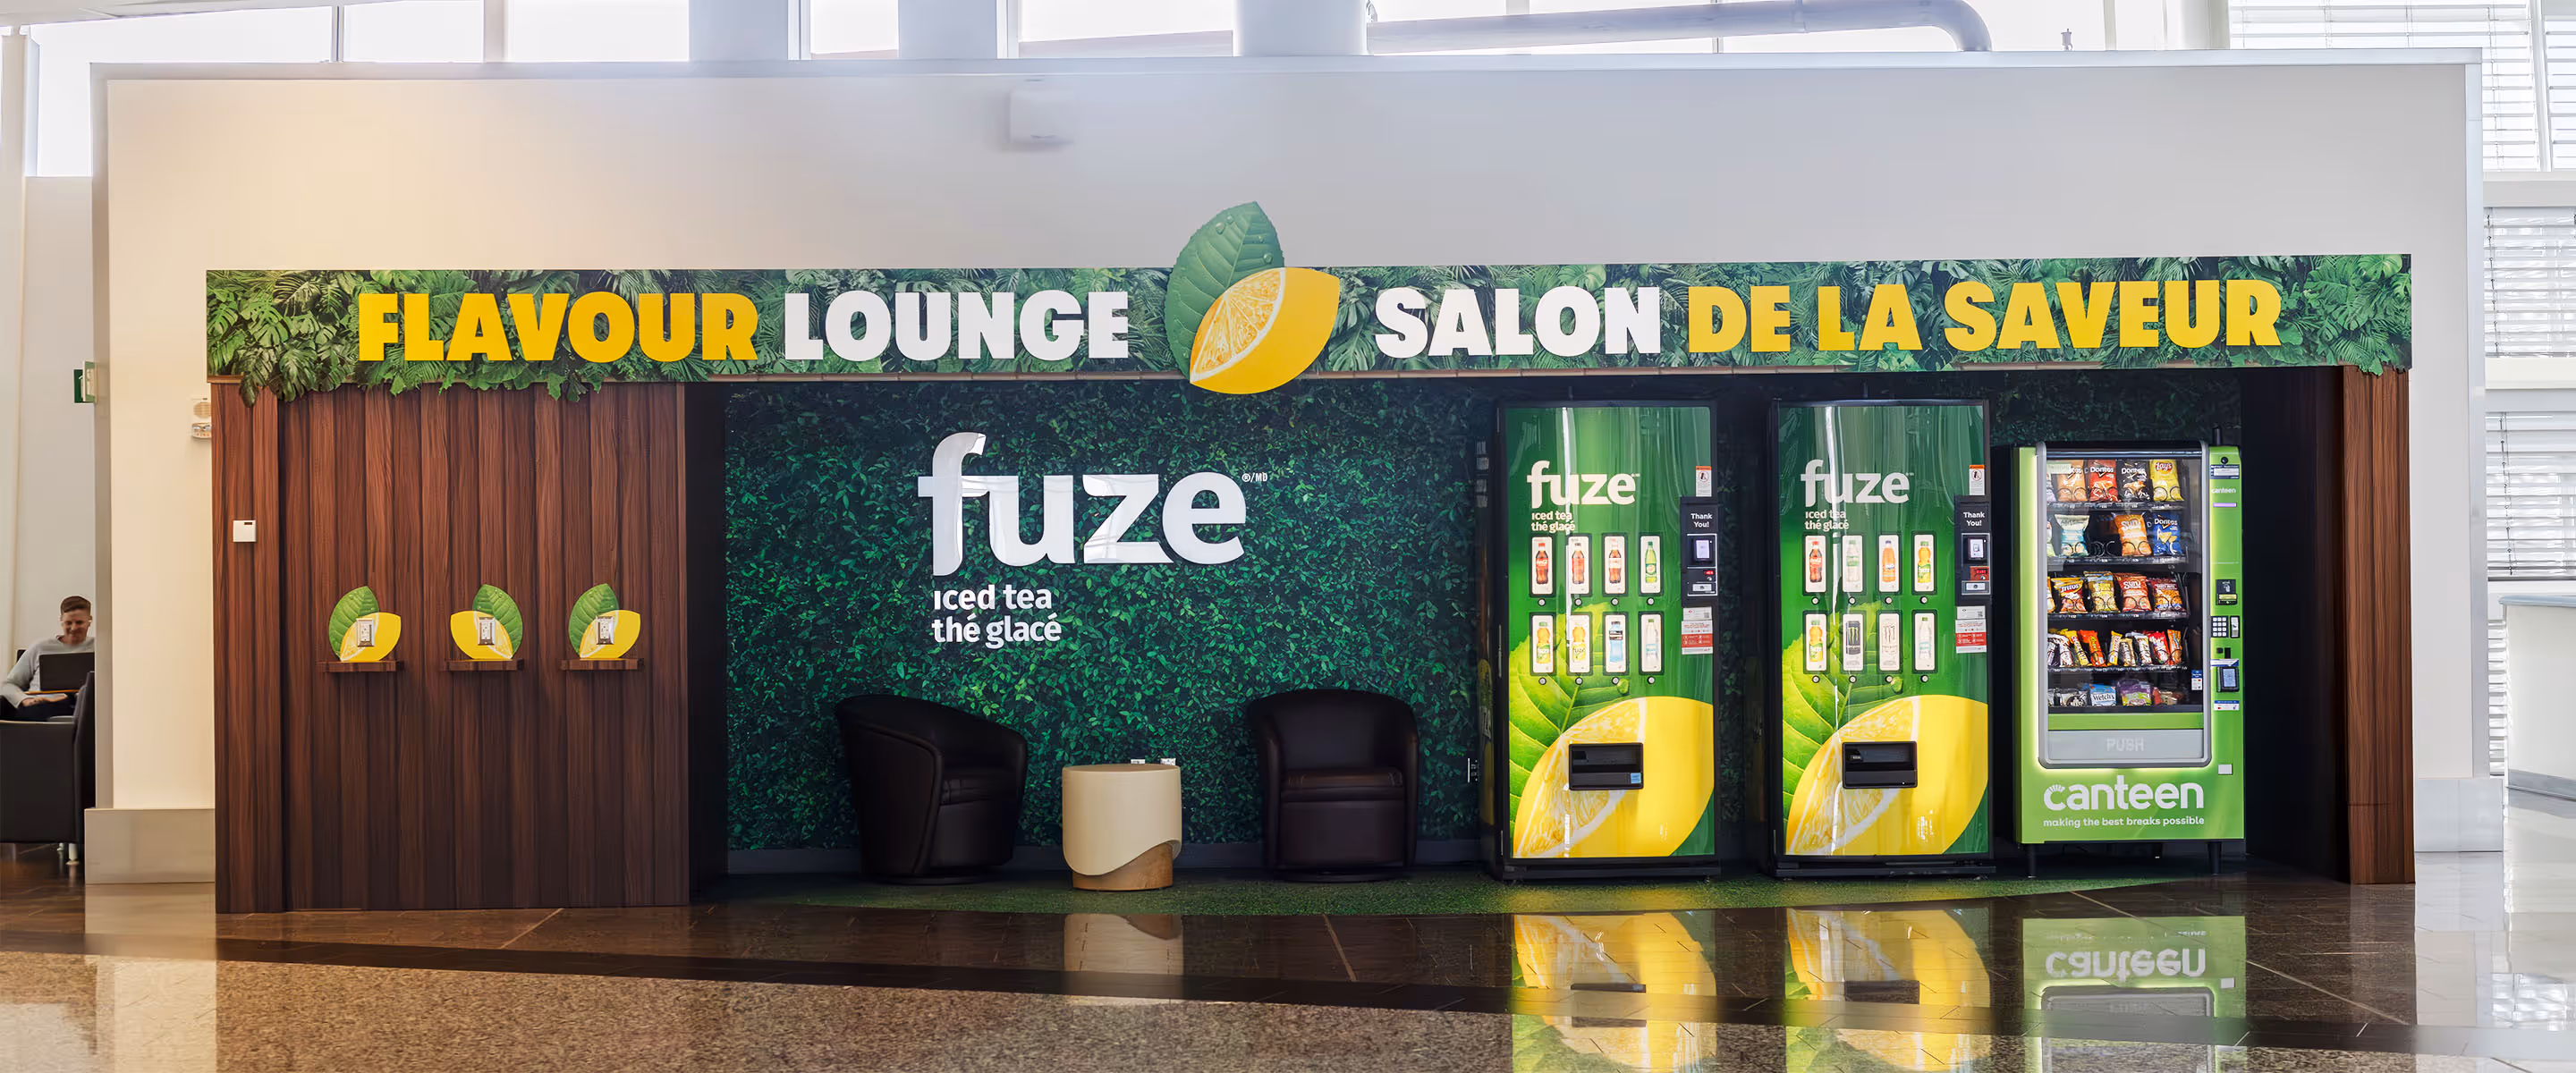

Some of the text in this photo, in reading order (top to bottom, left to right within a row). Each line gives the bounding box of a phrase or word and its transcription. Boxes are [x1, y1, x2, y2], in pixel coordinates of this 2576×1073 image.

[359, 290, 1130, 362] FLAVOUR LOUNGE
[1375, 279, 2282, 357] SALON DE LA SAVEUR
[2089, 466, 2114, 474] Doritos
[1526, 460, 1636, 509] fuze
[1800, 459, 1910, 508] fuze
[918, 432, 1247, 576] fuze
[1531, 511, 1572, 520] iced tea
[1805, 510, 1846, 519] iced tea
[2154, 518, 2178, 526] Doritos
[1530, 520, 1576, 534] thé glacé
[1804, 519, 1850, 532] thé glacé
[934, 584, 1052, 611] iced tea
[931, 613, 1063, 649] thé glacé
[2106, 738, 2145, 752] PUSH
[2043, 774, 2204, 811] canteen
[2043, 815, 2205, 829] making the best breaks possible
